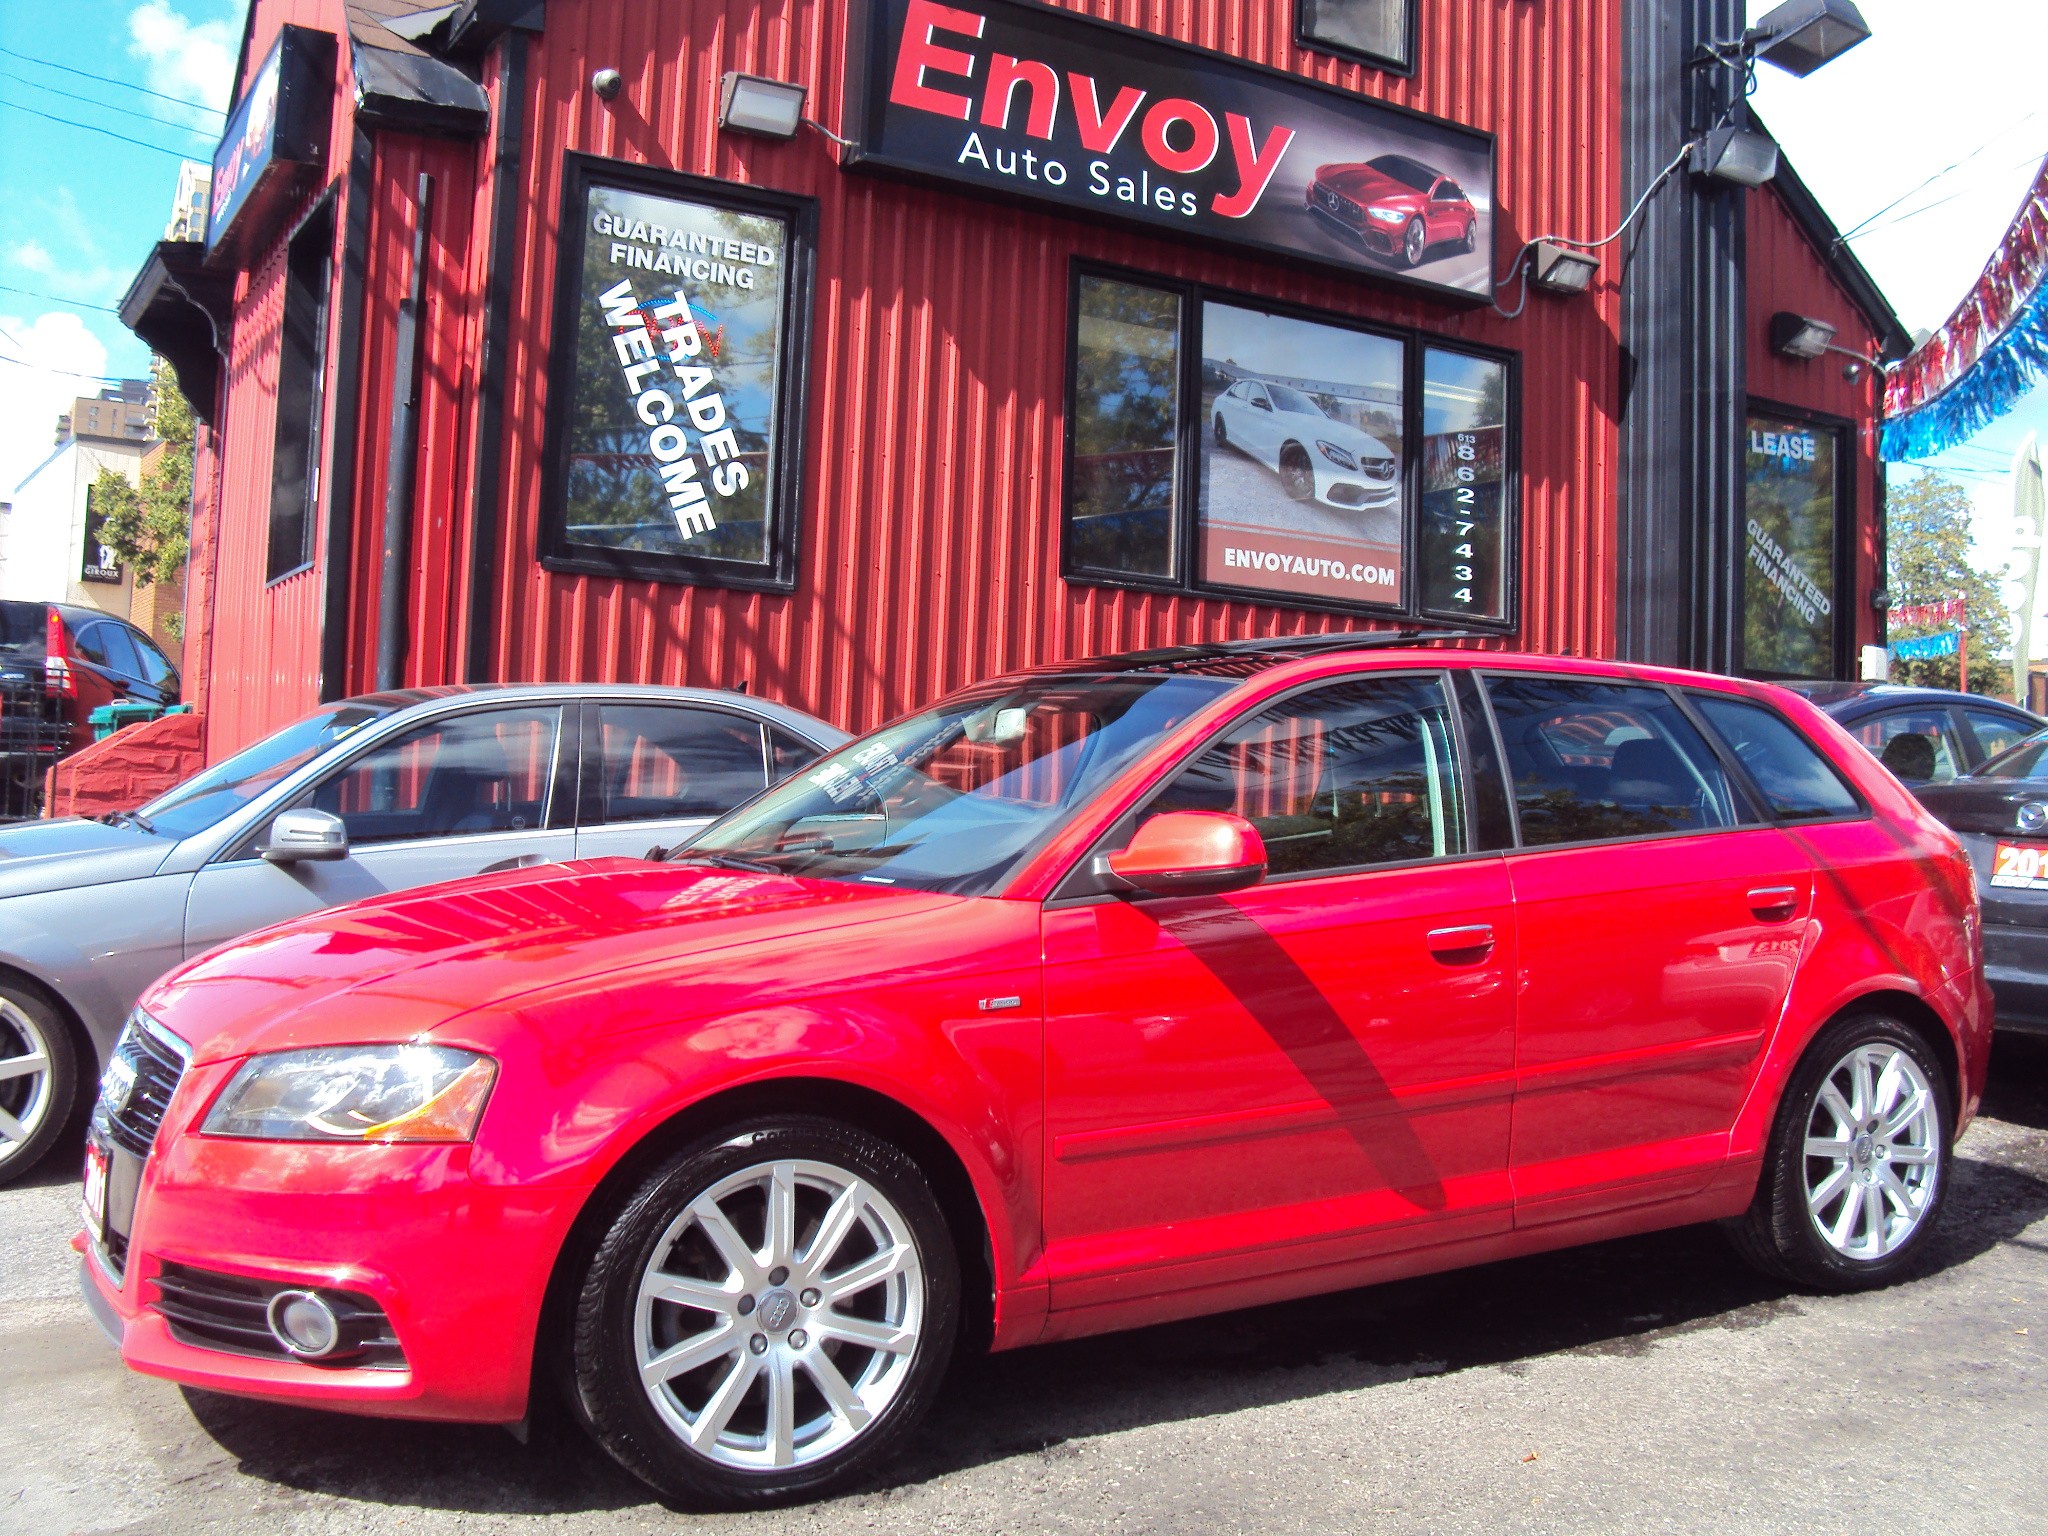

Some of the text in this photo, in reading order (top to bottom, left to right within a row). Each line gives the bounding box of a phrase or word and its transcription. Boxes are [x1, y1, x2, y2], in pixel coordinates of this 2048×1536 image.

[889, 0, 1296, 218] Envoy
[957, 132, 1198, 217] Auto Sales
[593, 212, 775, 266] GUARANTEED
[611, 242, 755, 289] FINANCING
[599, 279, 716, 540] WELCOME
[653, 290, 749, 497] TRADES
[1457, 433, 1476, 444] 613
[1751, 430, 1815, 461] LEASE
[84, 567, 119, 577] GIROUX
[1224, 548, 1395, 587] ENVOYAUTO.COM
[1747, 519, 1831, 616] GUARANTEED
[1749, 547, 1816, 625] FINANCING
